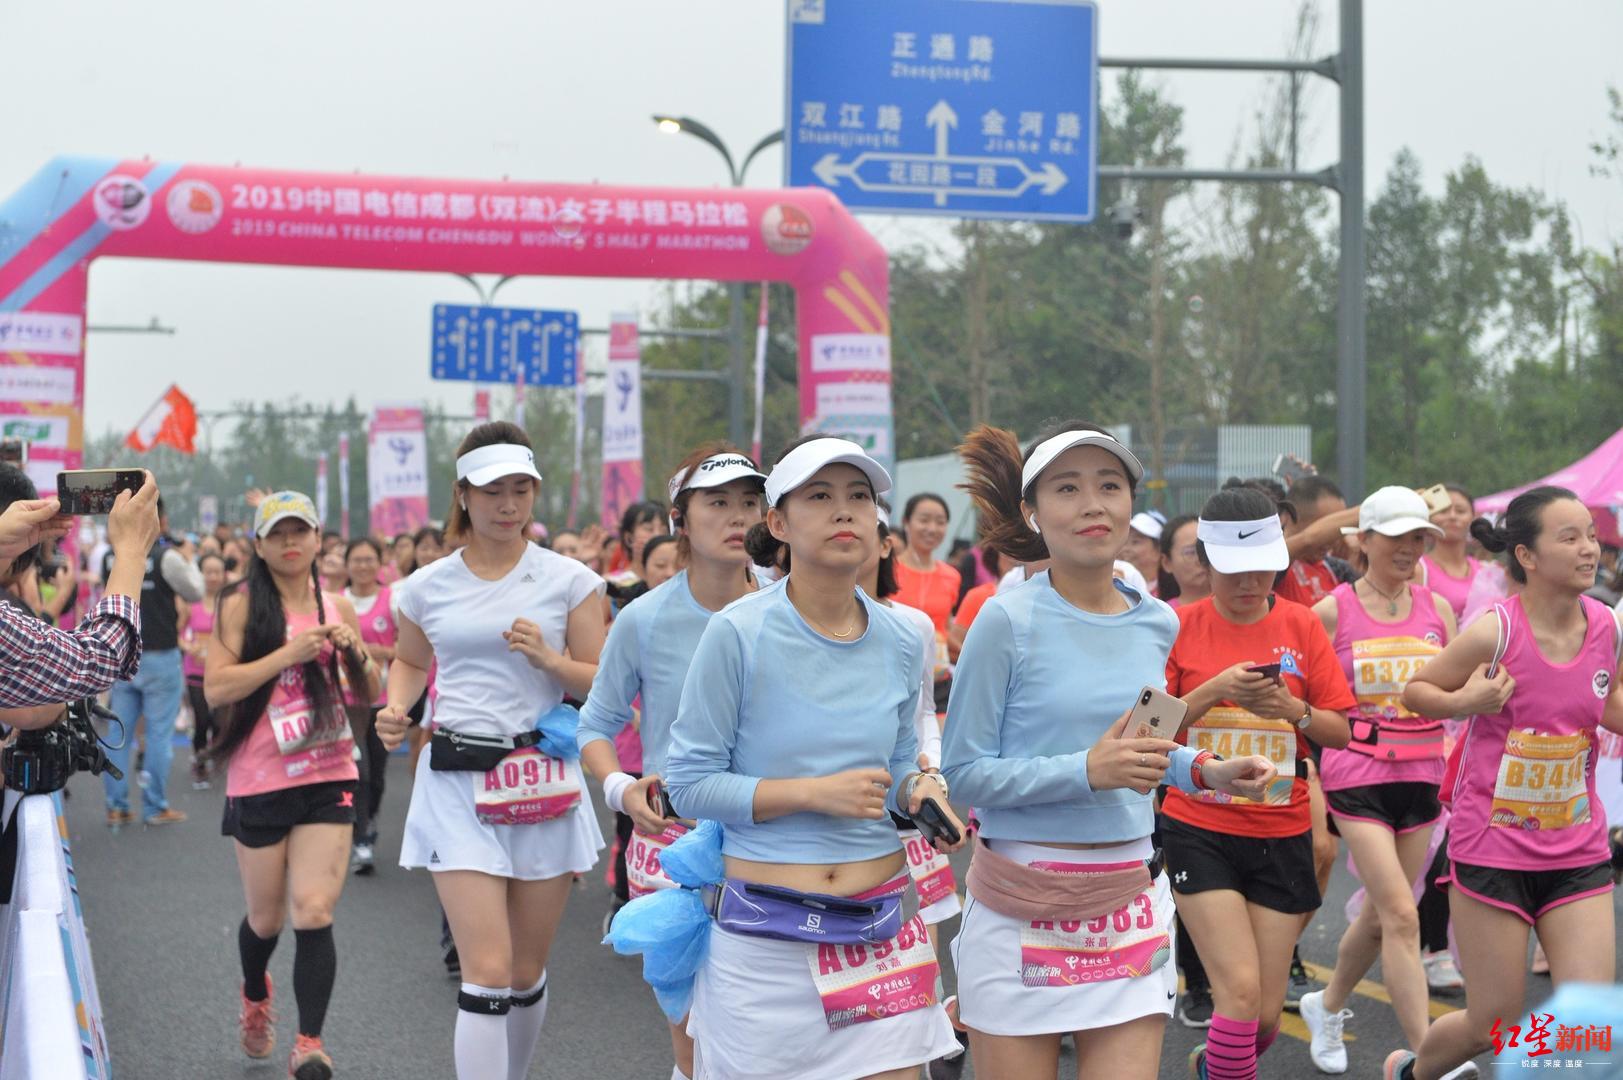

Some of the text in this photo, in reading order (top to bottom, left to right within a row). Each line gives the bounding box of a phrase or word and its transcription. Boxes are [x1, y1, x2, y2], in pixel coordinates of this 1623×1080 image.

[892, 32, 993, 62] 正通路
[801, 102, 901, 130] 双江路
[981, 108, 1081, 138] 金河路
[232, 218, 275, 236] 2019
[278, 222, 338, 239] CHINA
[342, 224, 422, 242] TELECOM
[427, 228, 513, 245] CHENGDU
[608, 232, 651, 249] HALF
[656, 234, 749, 250] MARATHON
[907, 836, 943, 866] 09
